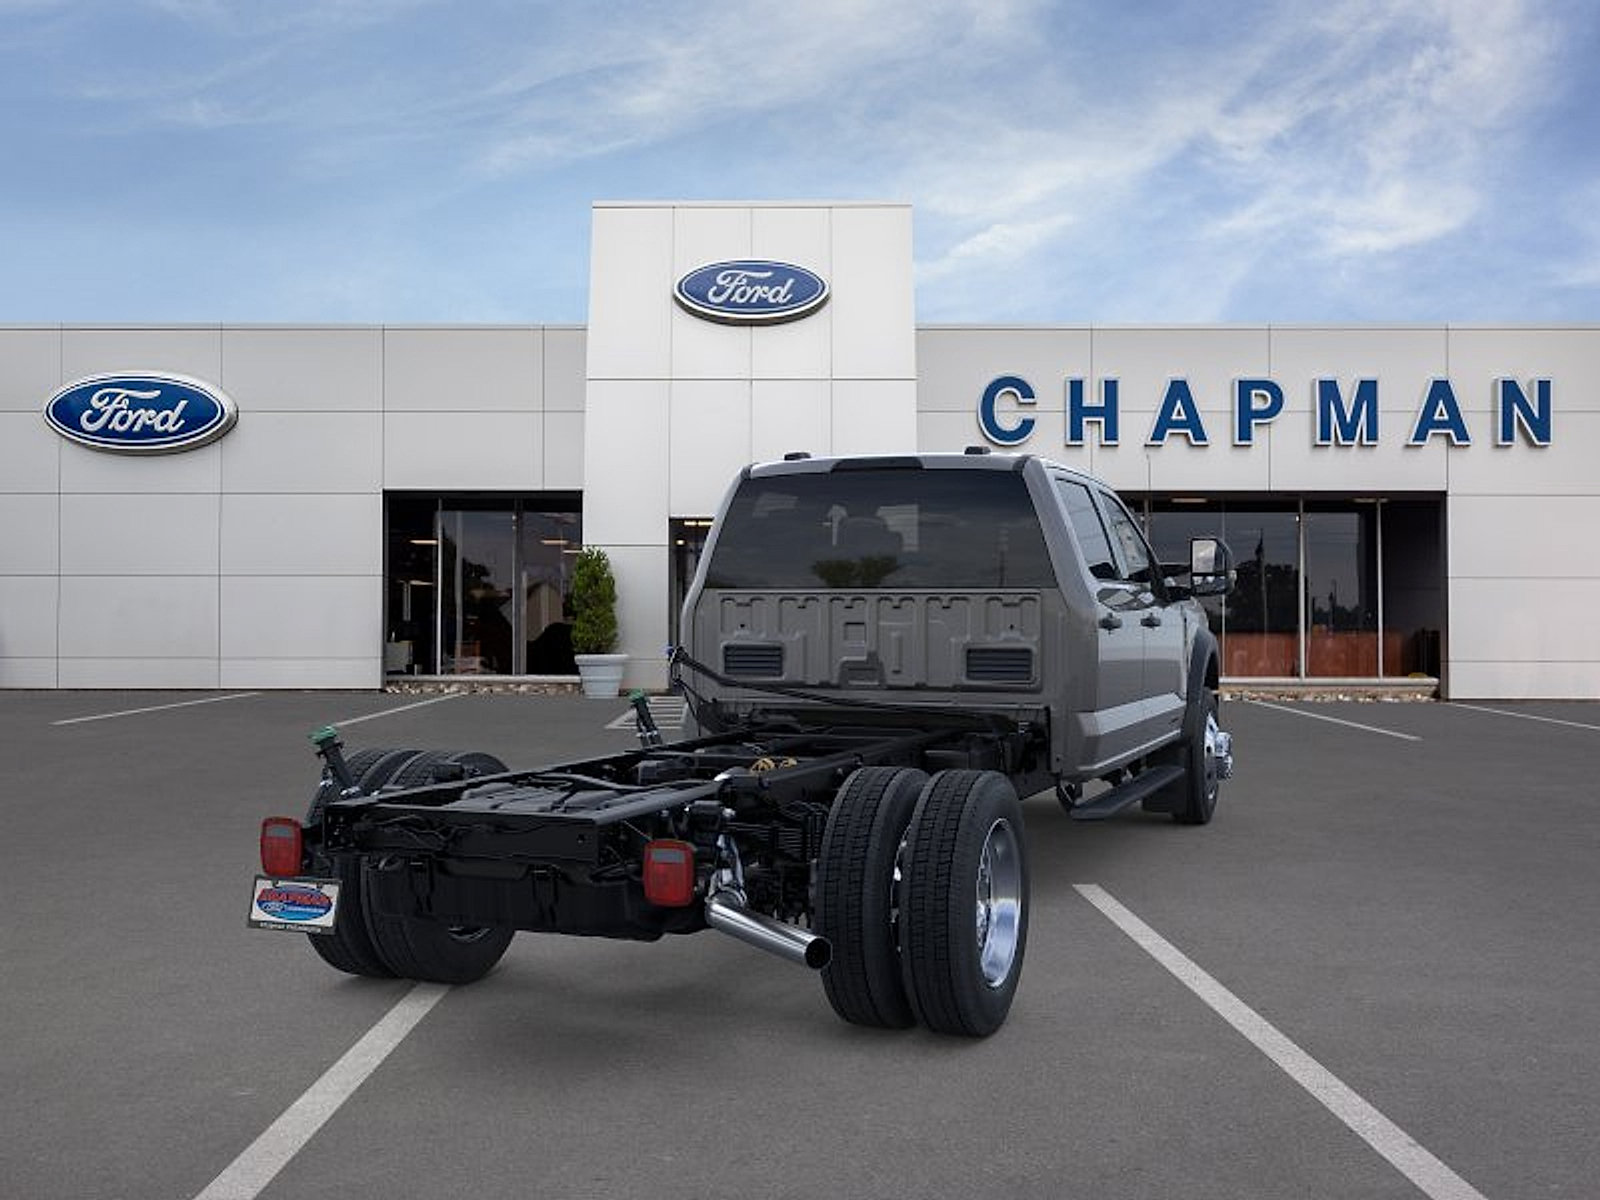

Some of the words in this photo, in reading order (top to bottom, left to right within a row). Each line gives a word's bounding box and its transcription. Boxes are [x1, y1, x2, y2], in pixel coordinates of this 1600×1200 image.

[707, 269, 795, 304] Ford
[80, 387, 189, 432] Ford
[977, 374, 1553, 446] CHAPMAN
